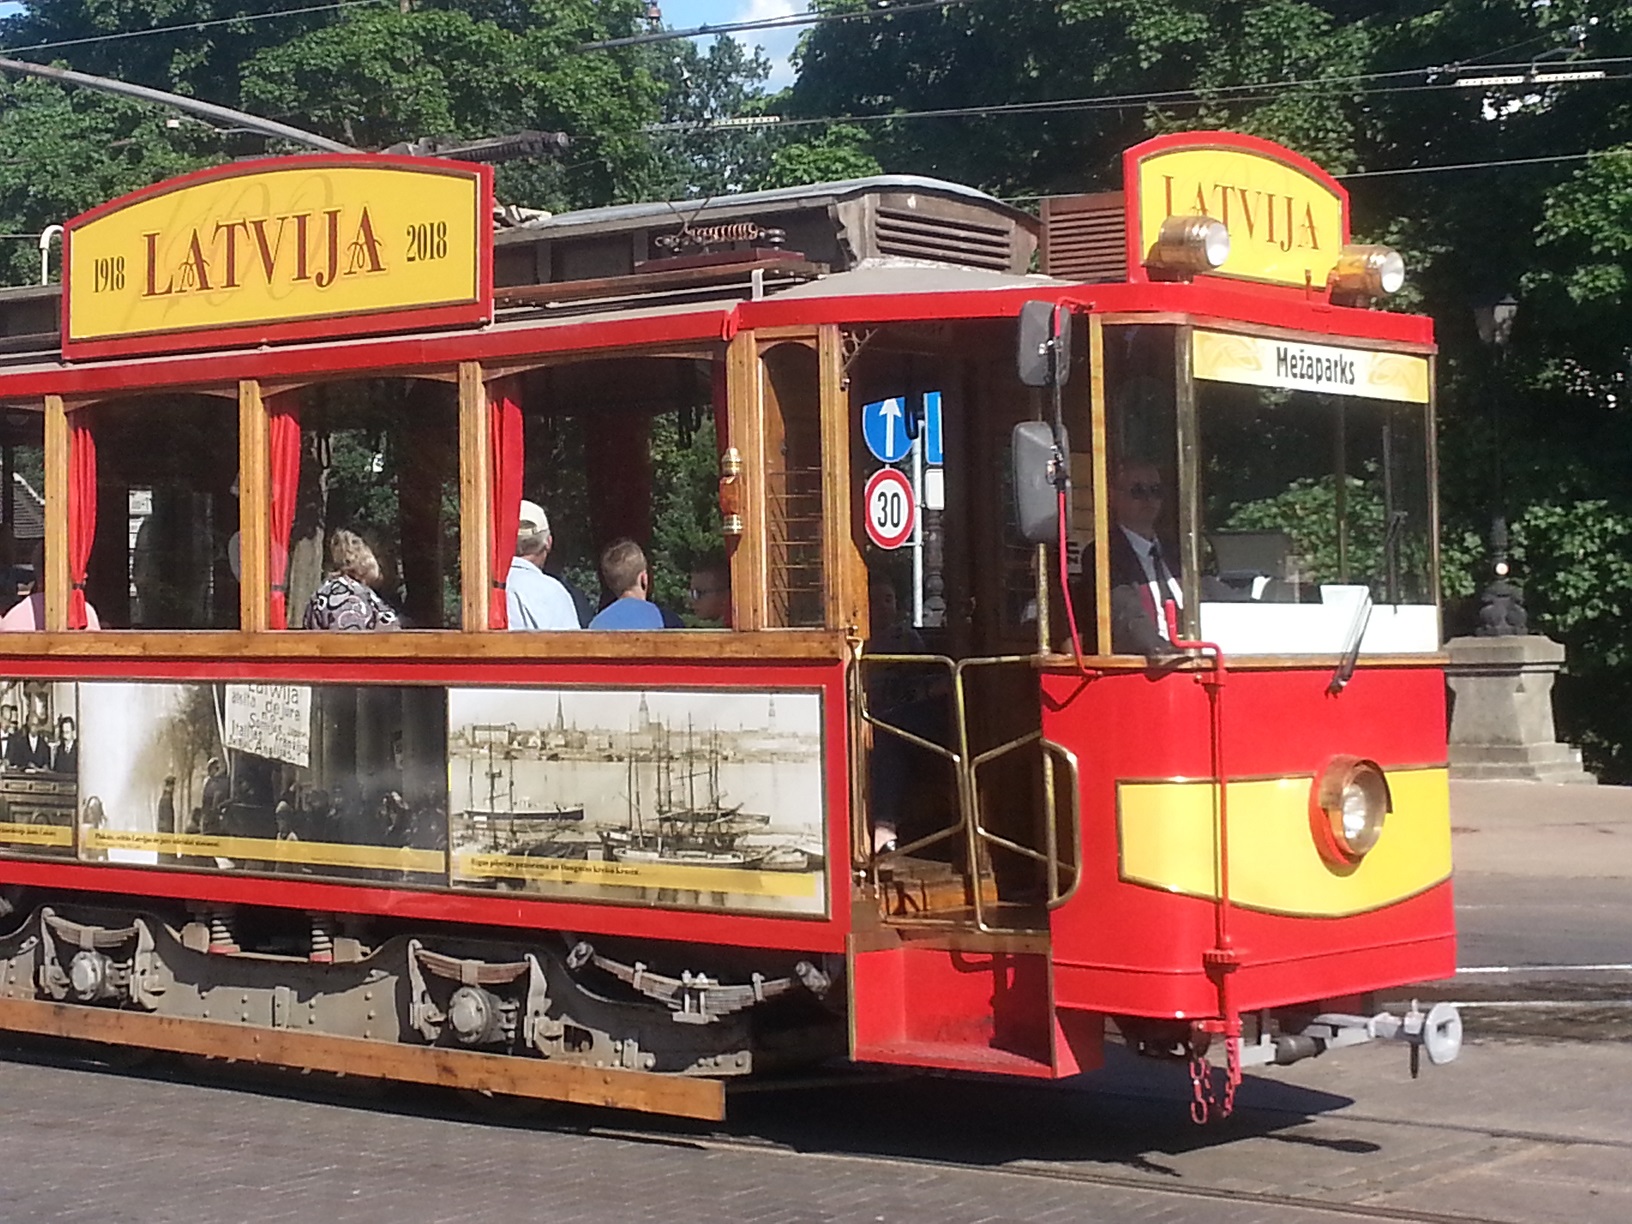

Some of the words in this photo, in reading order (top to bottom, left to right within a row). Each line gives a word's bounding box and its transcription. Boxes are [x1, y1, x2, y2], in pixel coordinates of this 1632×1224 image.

[93, 256, 125, 293] 1918
[141, 205, 387, 298] LATVIJA
[406, 221, 447, 262] 2018
[1276, 345, 1356, 385] Mežaparks
[877, 491, 901, 528] 30
